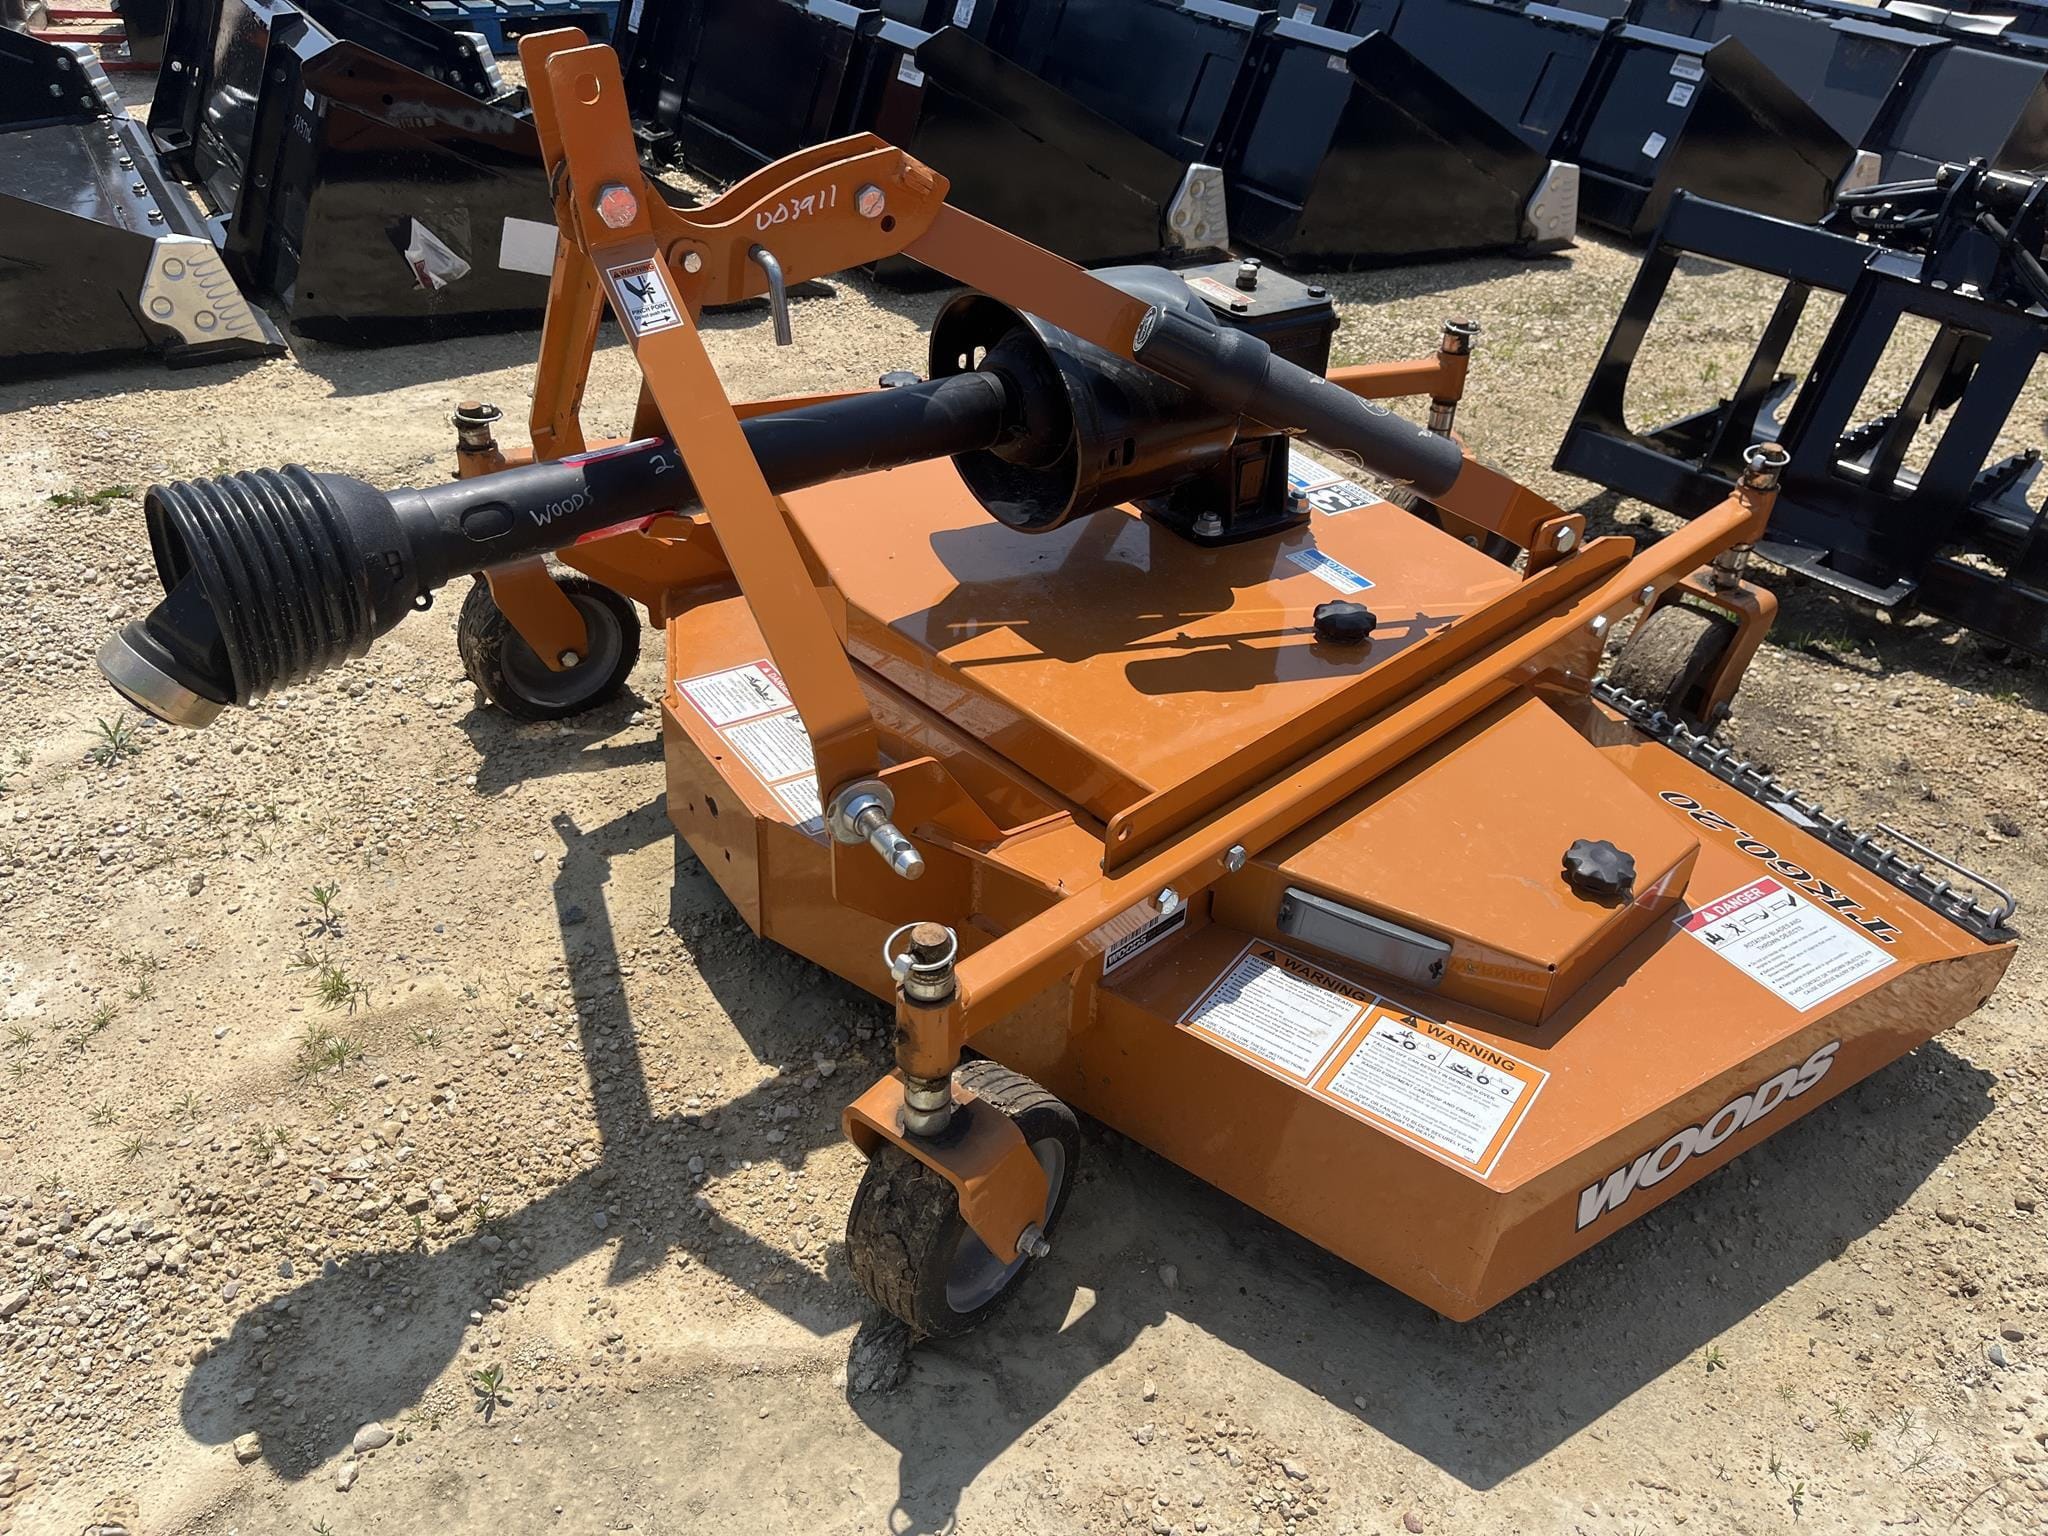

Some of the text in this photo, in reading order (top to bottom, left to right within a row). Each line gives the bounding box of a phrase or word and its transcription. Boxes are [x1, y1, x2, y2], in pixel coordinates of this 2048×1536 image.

[619, 263, 656, 276] WARNING
[632, 305, 650, 315] PINCH
[529, 484, 594, 527] WOODS
[1714, 887, 1766, 915] DANGER
[1284, 958, 1366, 1001] WARNING
[1427, 1024, 1516, 1071] WARNING
[1576, 1039, 1842, 1232] WOODS
